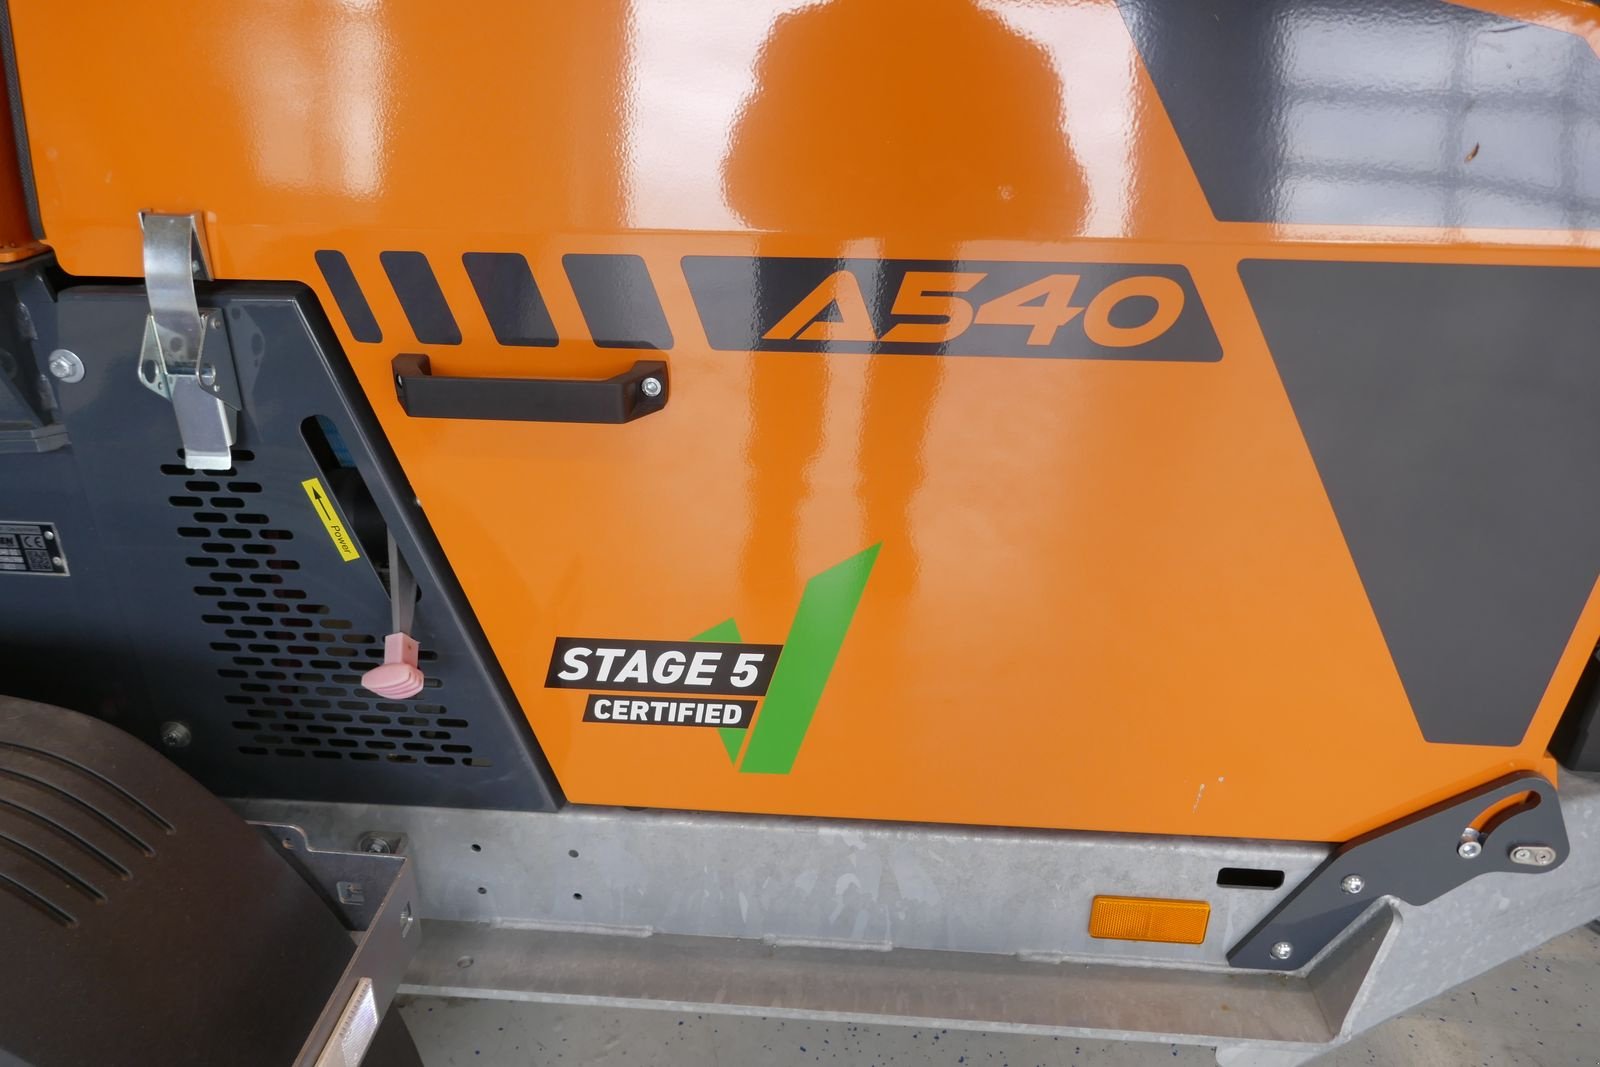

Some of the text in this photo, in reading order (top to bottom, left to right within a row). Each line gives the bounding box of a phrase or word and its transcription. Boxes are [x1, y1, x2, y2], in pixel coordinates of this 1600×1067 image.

[761, 269, 1186, 348] A540
[24, 535, 43, 548] CE
[331, 525, 351, 554] Power
[557, 646, 765, 688] STAGE 5
[593, 699, 743, 725] CERTIFIED
